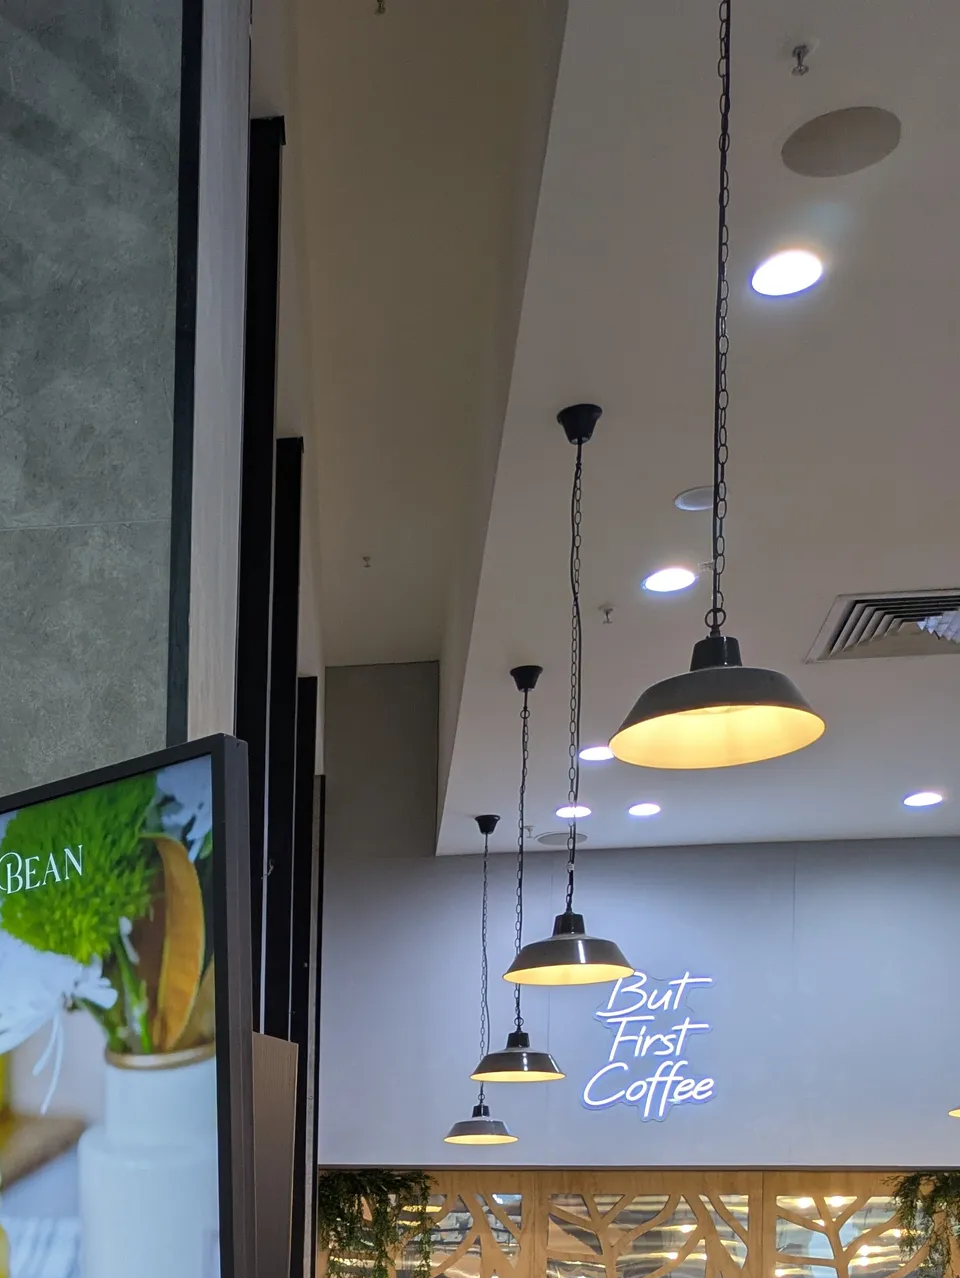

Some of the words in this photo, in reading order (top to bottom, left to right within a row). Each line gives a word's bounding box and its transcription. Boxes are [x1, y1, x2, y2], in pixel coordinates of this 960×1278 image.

[596, 971, 713, 1017] But
[606, 1017, 709, 1062] First
[583, 1060, 715, 1118] Coffee
